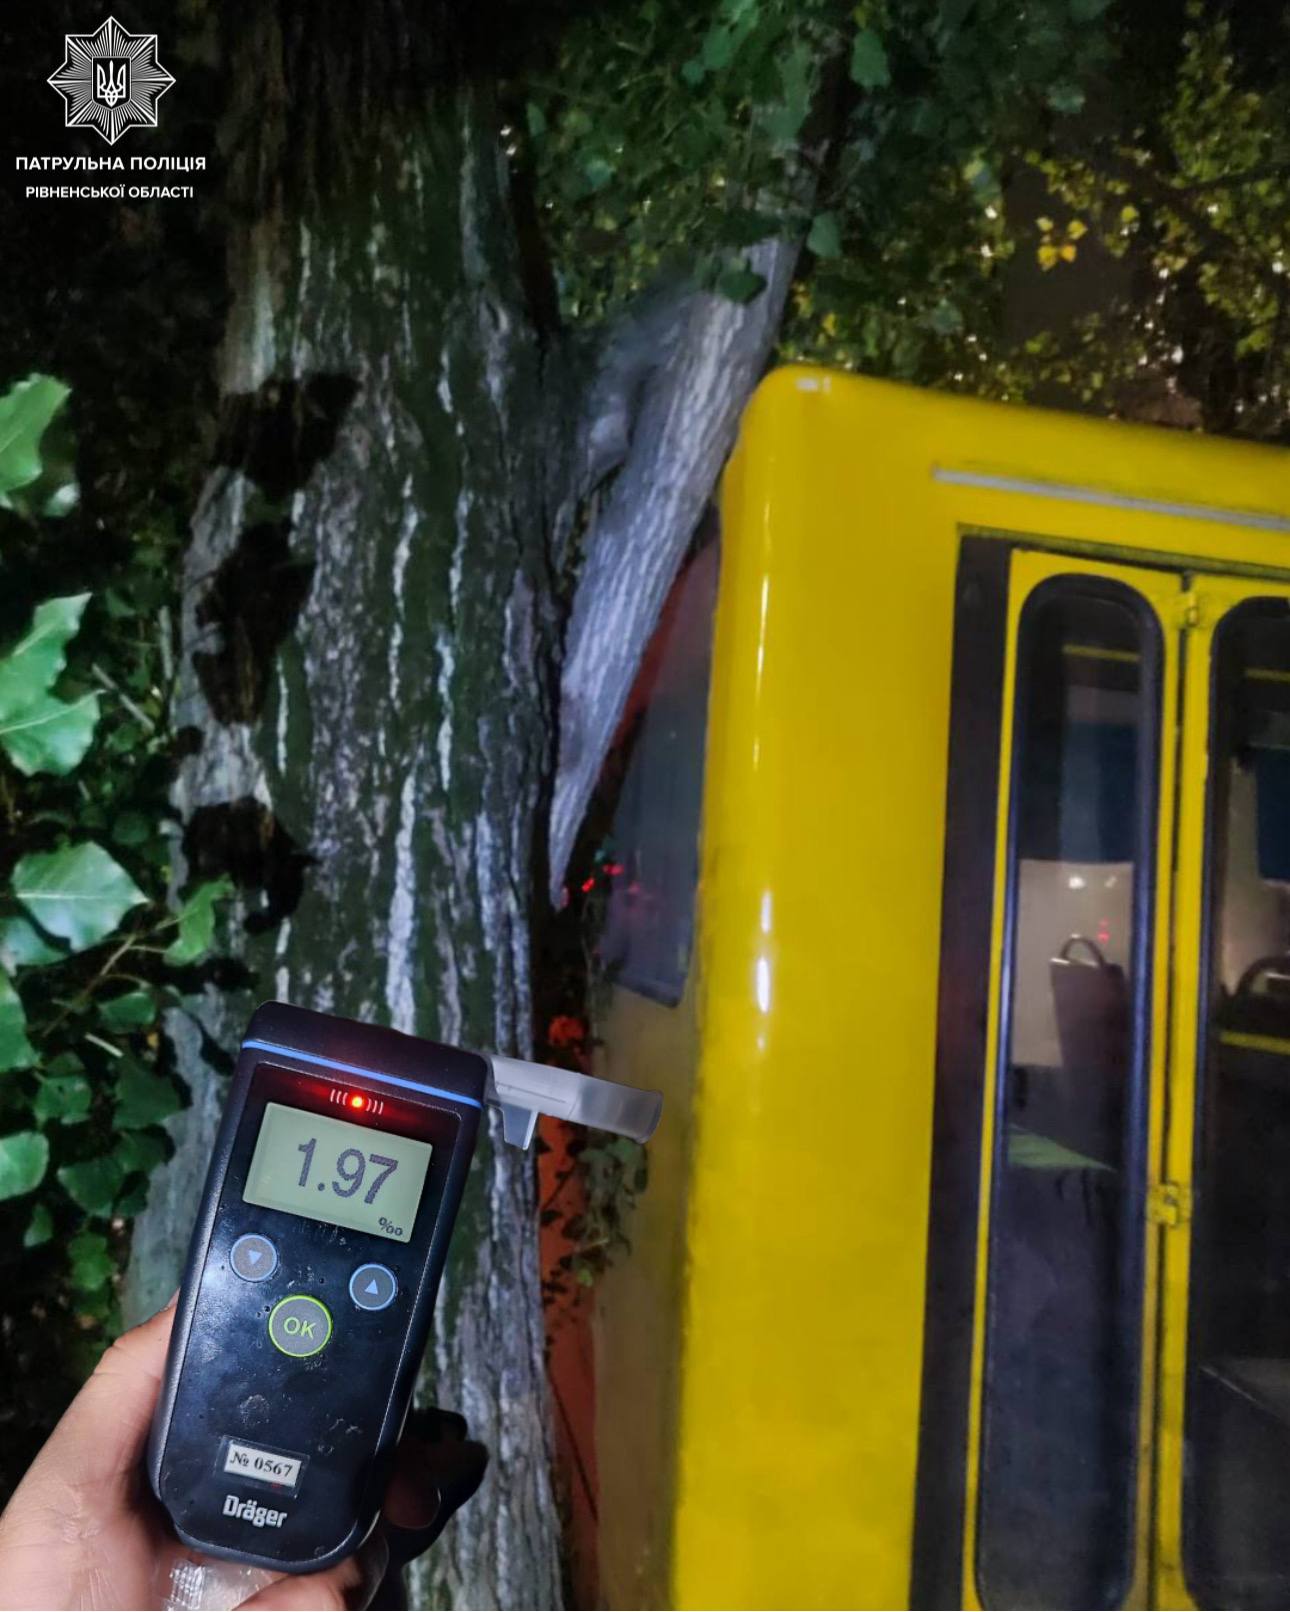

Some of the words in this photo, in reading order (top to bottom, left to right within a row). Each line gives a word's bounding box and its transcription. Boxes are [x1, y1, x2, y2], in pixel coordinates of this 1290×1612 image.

[297, 1137, 399, 1205] 1.97
[283, 1316, 317, 1340] OK
[254, 1456, 293, 1478] 0567
[222, 1494, 288, 1528] Dräger
